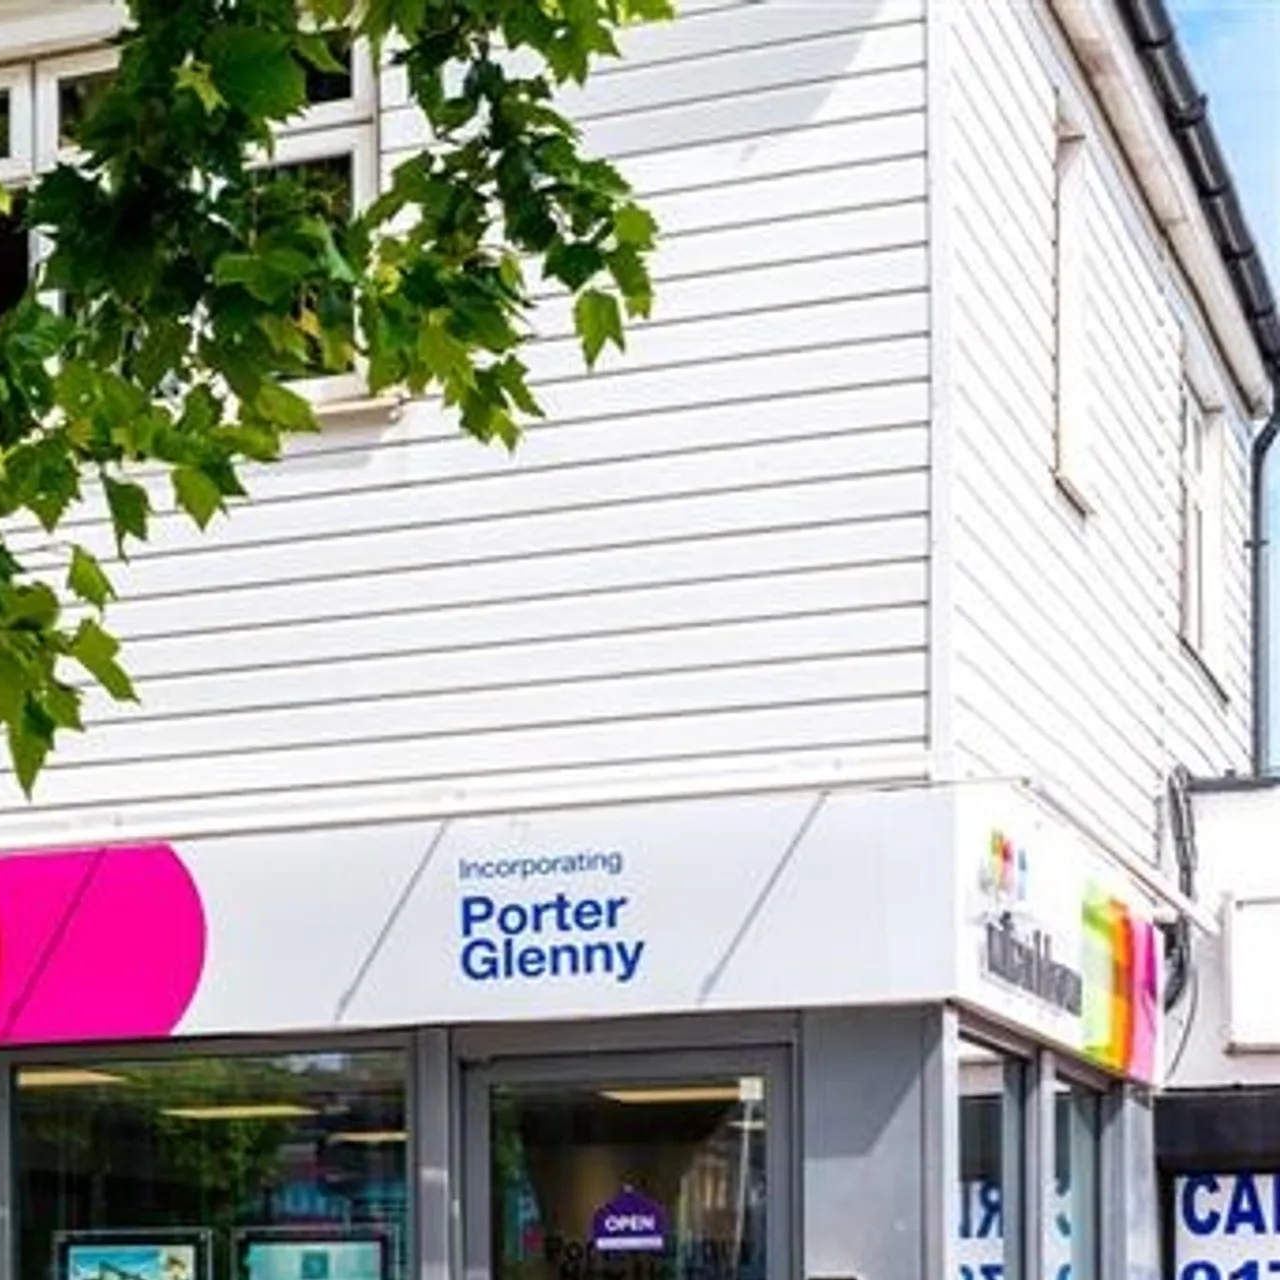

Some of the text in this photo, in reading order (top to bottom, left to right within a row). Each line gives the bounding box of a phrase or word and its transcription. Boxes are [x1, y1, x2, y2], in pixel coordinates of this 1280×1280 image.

[459, 852, 622, 879] Incorporating
[461, 893, 628, 936] Porter
[461, 938, 645, 982] Glenny
[604, 1214, 656, 1232] OPEN
[1181, 1173, 1280, 1235] CA
